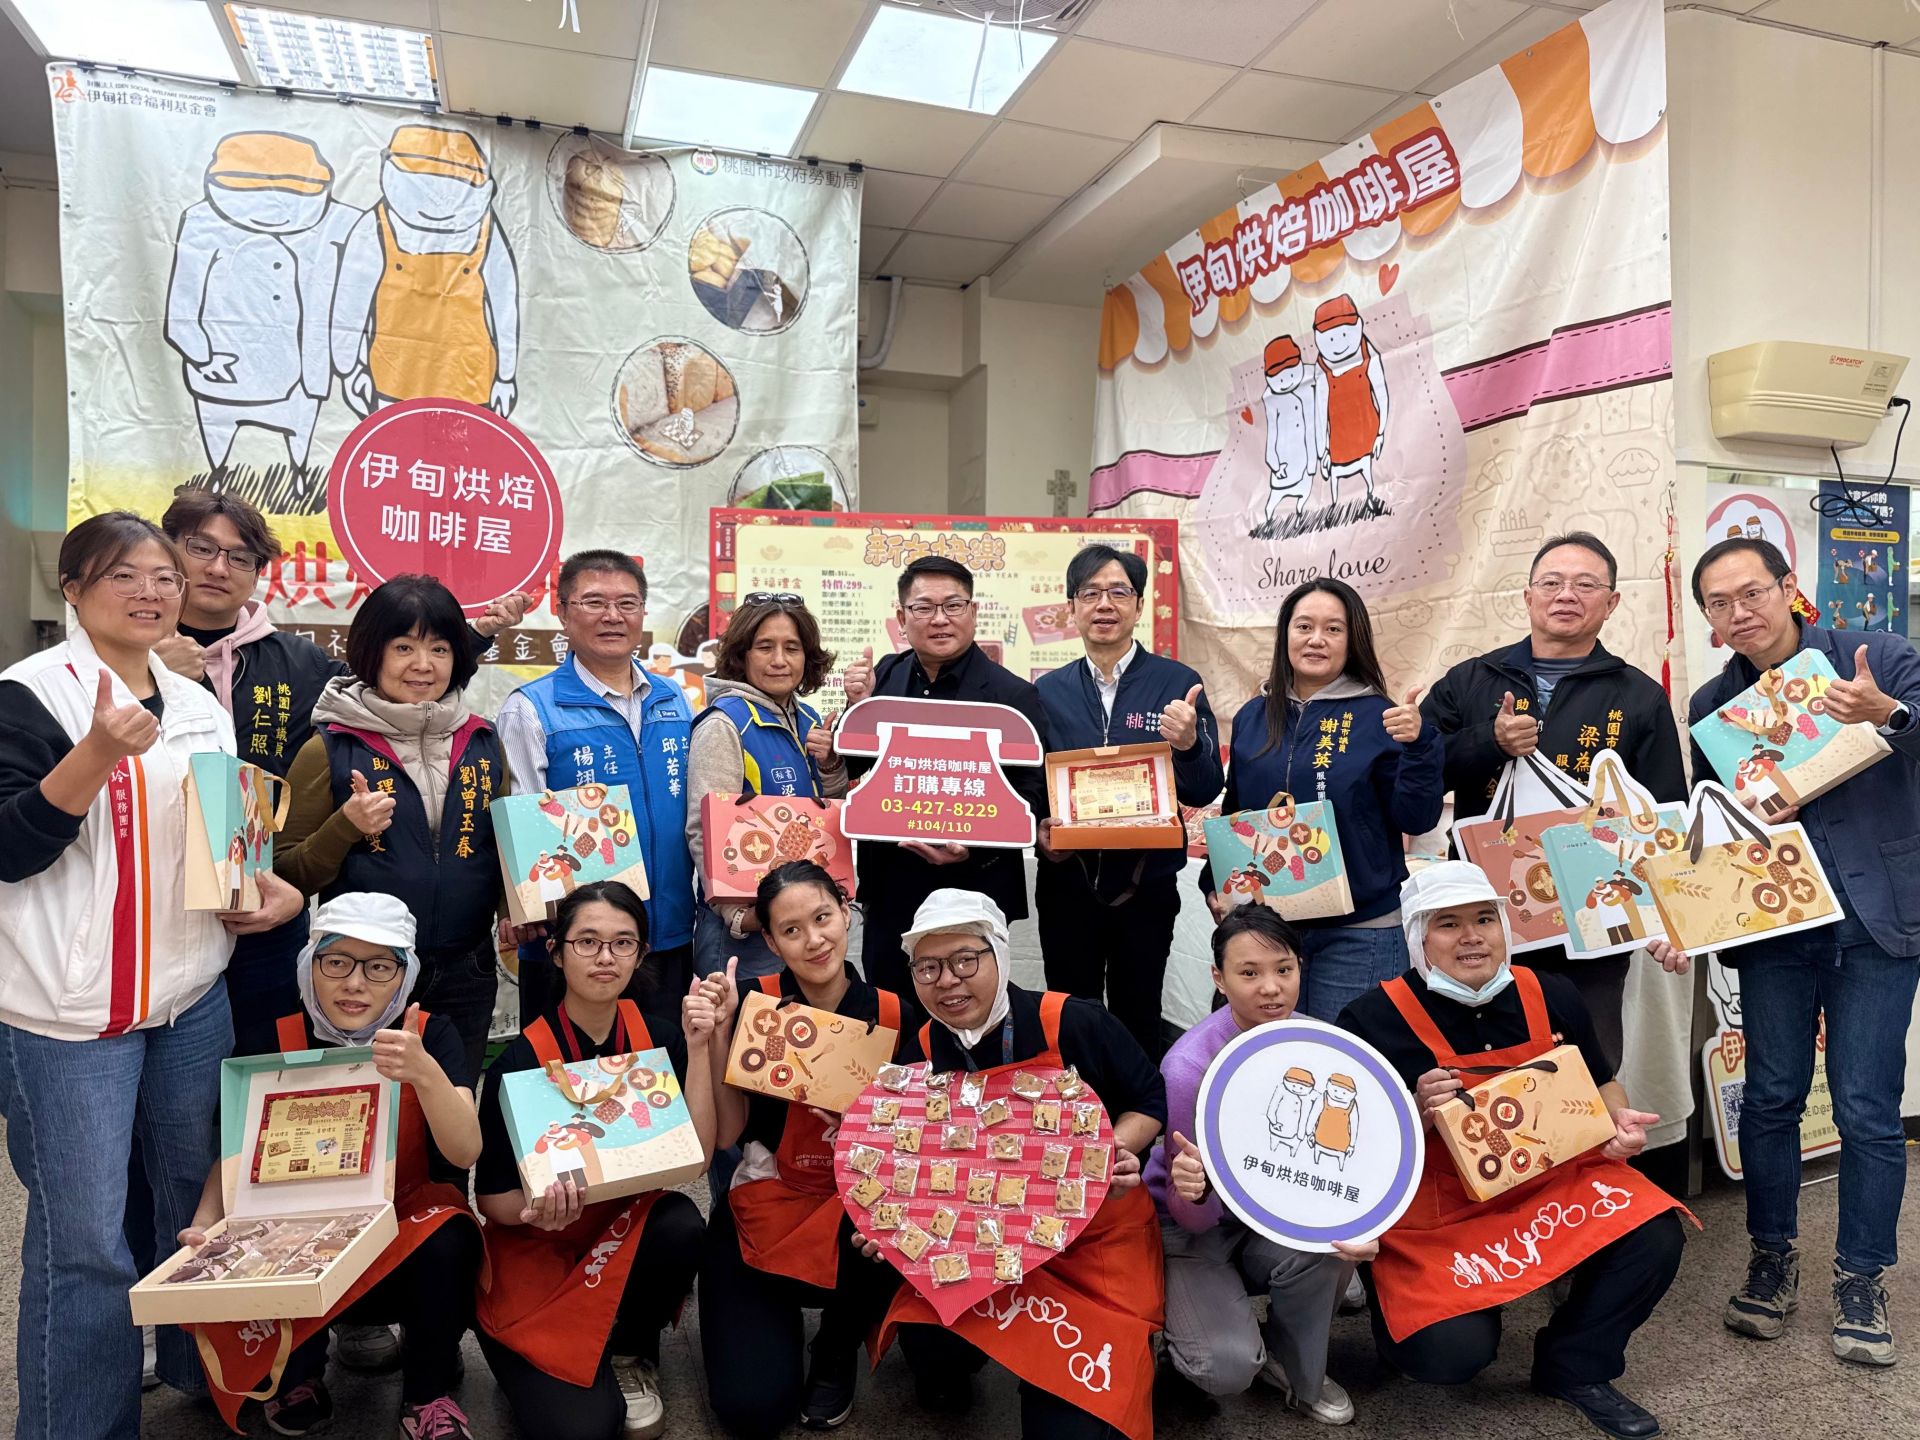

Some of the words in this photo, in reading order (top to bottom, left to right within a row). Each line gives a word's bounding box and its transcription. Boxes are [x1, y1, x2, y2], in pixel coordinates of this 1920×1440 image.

[87, 89, 217, 118] 伊甸社會福利基金會
[151, 89, 177, 97] WELFARE
[178, 93, 216, 103] FOUNDATION
[721, 155, 859, 190] 桃園市政府勞動局
[1180, 134, 1454, 311] 伊甸烘焙咖啡屋
[359, 451, 535, 511] 伊甸烘焙
[381, 504, 512, 554] 咖啡屋
[751, 577, 802, 589] 幸福禮盒
[1258, 556, 1321, 590] Share
[1328, 548, 1392, 580] love
[250, 685, 272, 756] 劉仁照
[274, 682, 292, 758] 桃園市議員
[1515, 698, 1530, 711] 助
[1312, 717, 1339, 769] 謝美英
[1338, 712, 1354, 753] 桃園市議員
[1605, 709, 1624, 750] 桃園市
[372, 756, 397, 795] 助理
[603, 744, 618, 775] 主任
[661, 737, 682, 798] 邱若華
[774, 768, 793, 780] 秘書
[888, 755, 993, 775] 伊甸烘焙咖啡屋
[479, 757, 493, 813] 市議員
[893, 773, 987, 798] 訂購專線
[115, 789, 129, 838] 服務團隊
[455, 765, 478, 859] 劉曾玉春
[881, 798, 999, 818] 03-427-8229
[907, 819, 972, 834] #104/110
[1243, 1154, 1361, 1204] 伊甸烘焙咖啡屋
